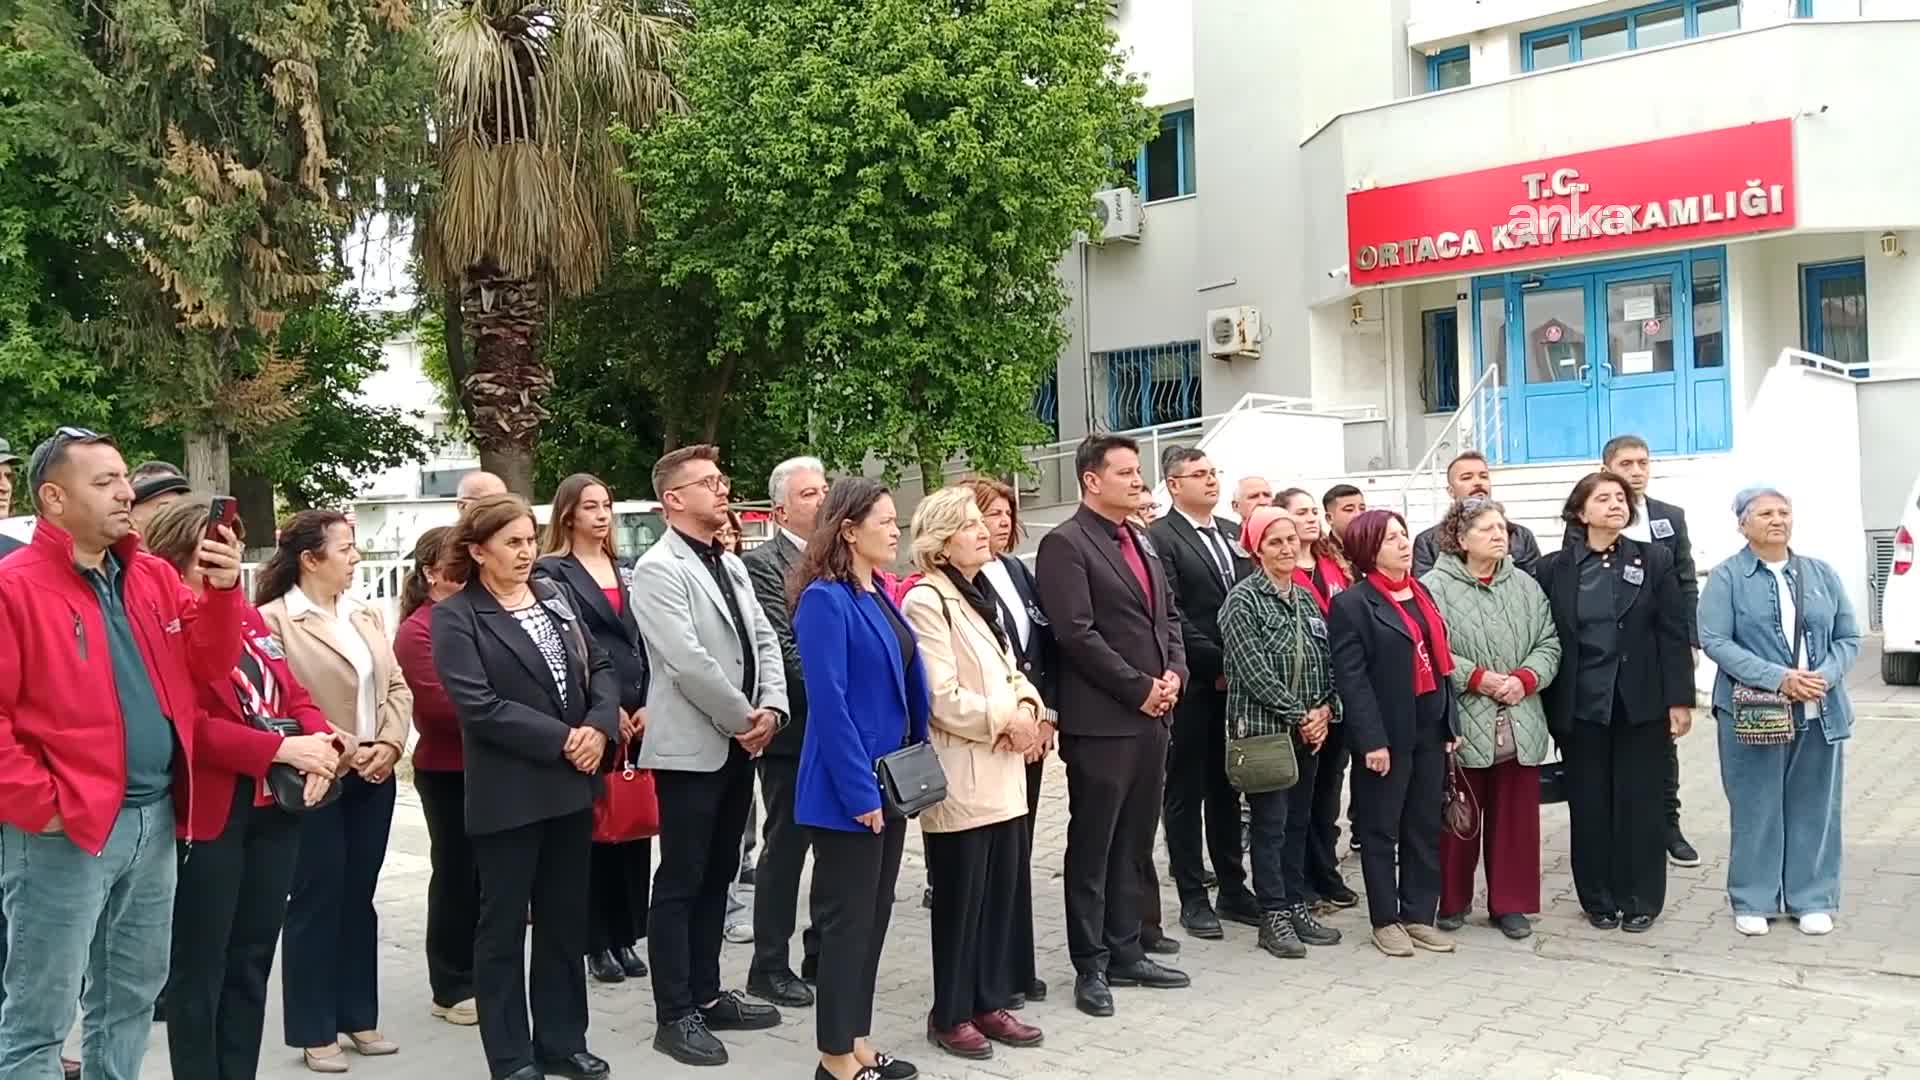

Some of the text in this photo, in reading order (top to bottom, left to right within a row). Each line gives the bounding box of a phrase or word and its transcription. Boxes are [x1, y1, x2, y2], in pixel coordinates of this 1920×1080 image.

[1520, 167, 1590, 201] T.C.
[1357, 178, 1784, 271] ORTACA KAYMKAMLIĞI
